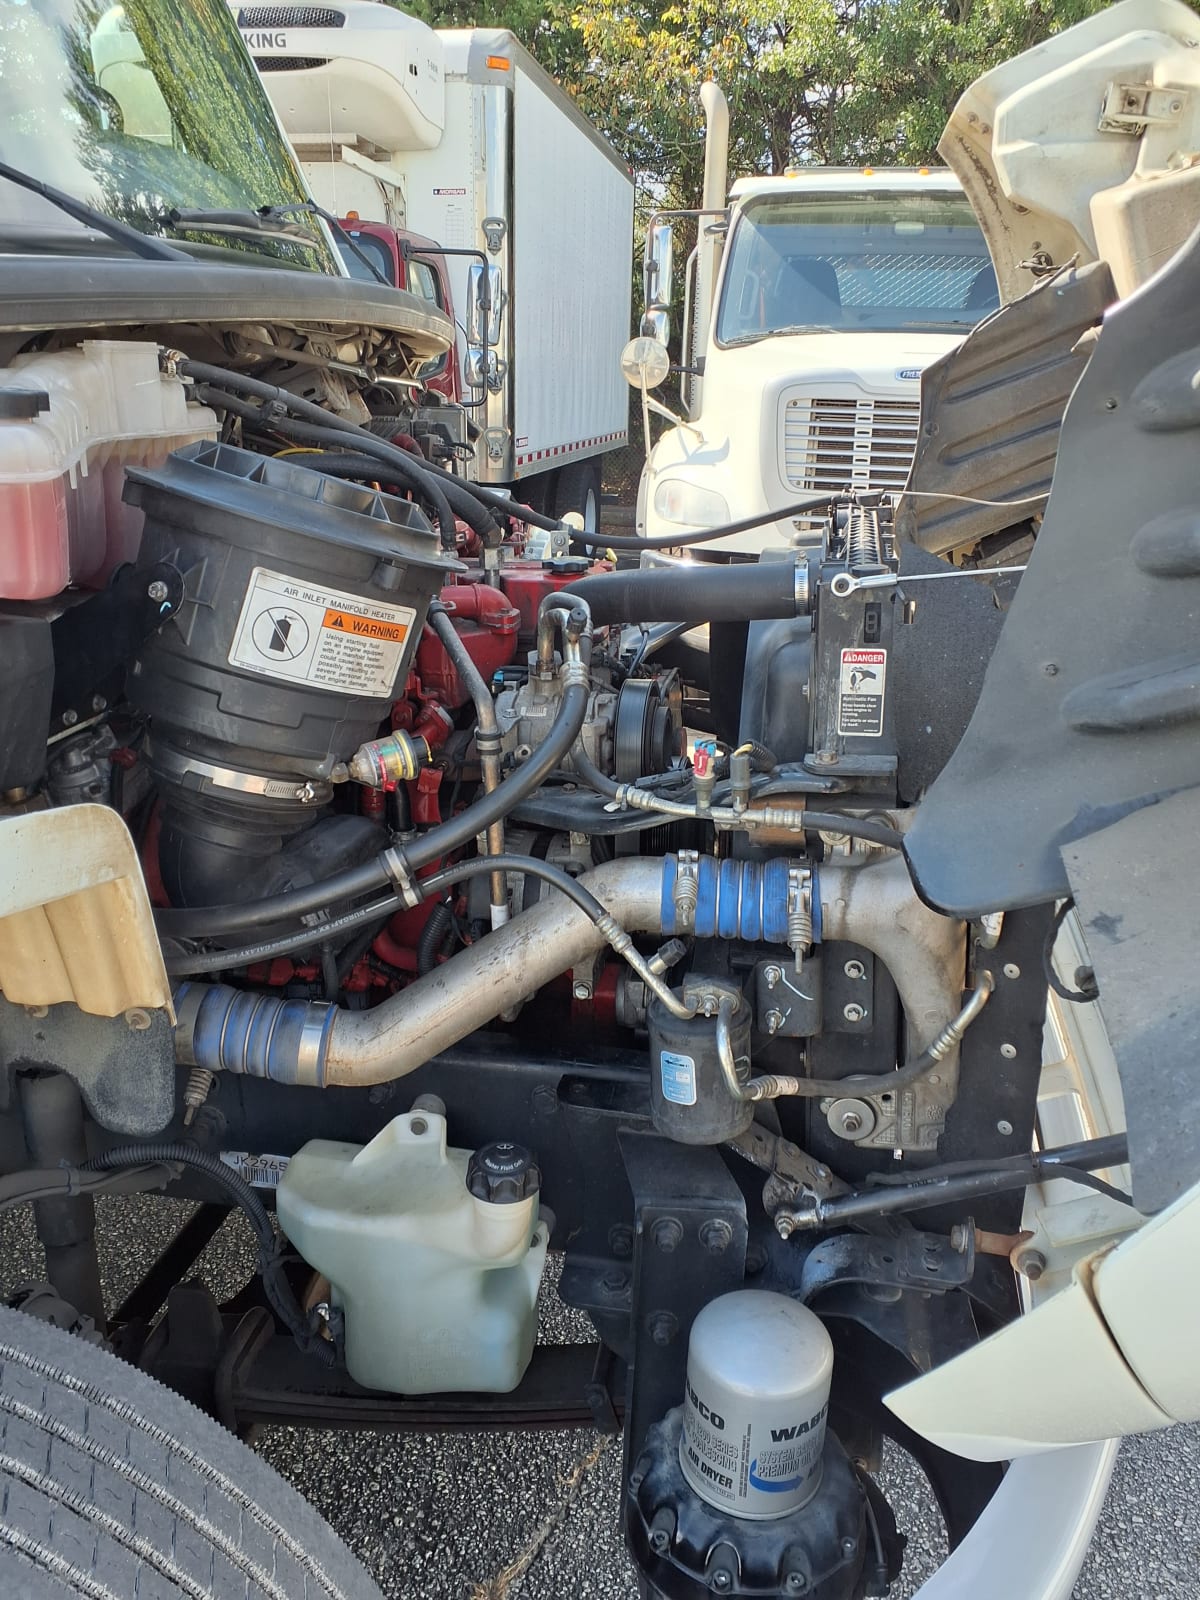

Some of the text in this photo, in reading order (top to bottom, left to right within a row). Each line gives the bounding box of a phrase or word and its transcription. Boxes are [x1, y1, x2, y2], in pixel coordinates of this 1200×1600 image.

[244, 33, 287, 48] KING
[283, 586, 396, 621] AIR INLET MANIFOLD HEATER
[352, 620, 400, 640] WARNING
[326, 633, 343, 642] Using
[346, 637, 367, 648] starting
[322, 646, 335, 654] with
[343, 644, 362, 653] engine
[320, 653, 337, 661] could
[852, 654, 884, 663] DANGER
[318, 661, 343, 671] possibly
[688, 1446, 700, 1467] AIR
[701, 1461, 733, 1490] DRYER
[758, 1459, 800, 1478] PREMIUM
